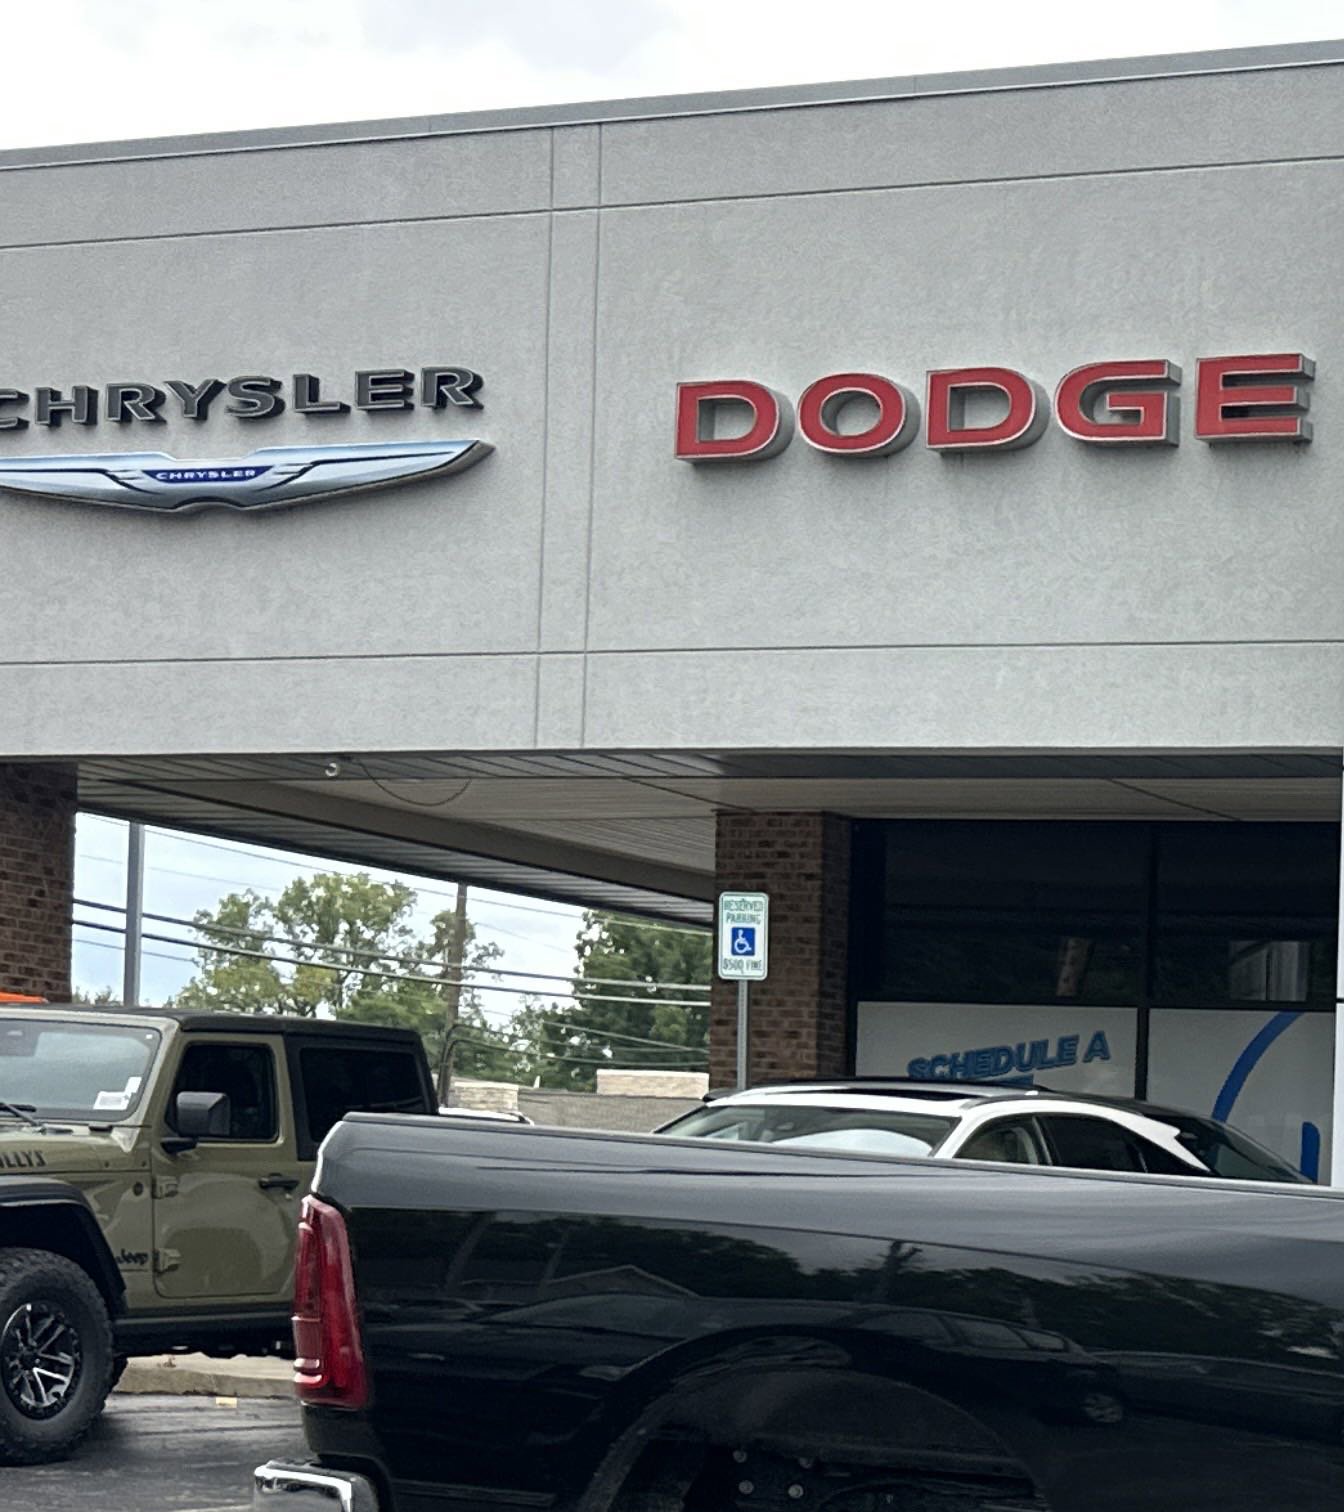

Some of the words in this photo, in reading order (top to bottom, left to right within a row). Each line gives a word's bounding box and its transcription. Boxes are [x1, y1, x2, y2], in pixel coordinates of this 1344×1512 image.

[675, 353, 1315, 464] DODGE
[156, 469, 256, 480] CHRYSLER
[907, 1034, 1079, 1080] SCHEDULE
[1081, 1030, 1111, 1063] A
